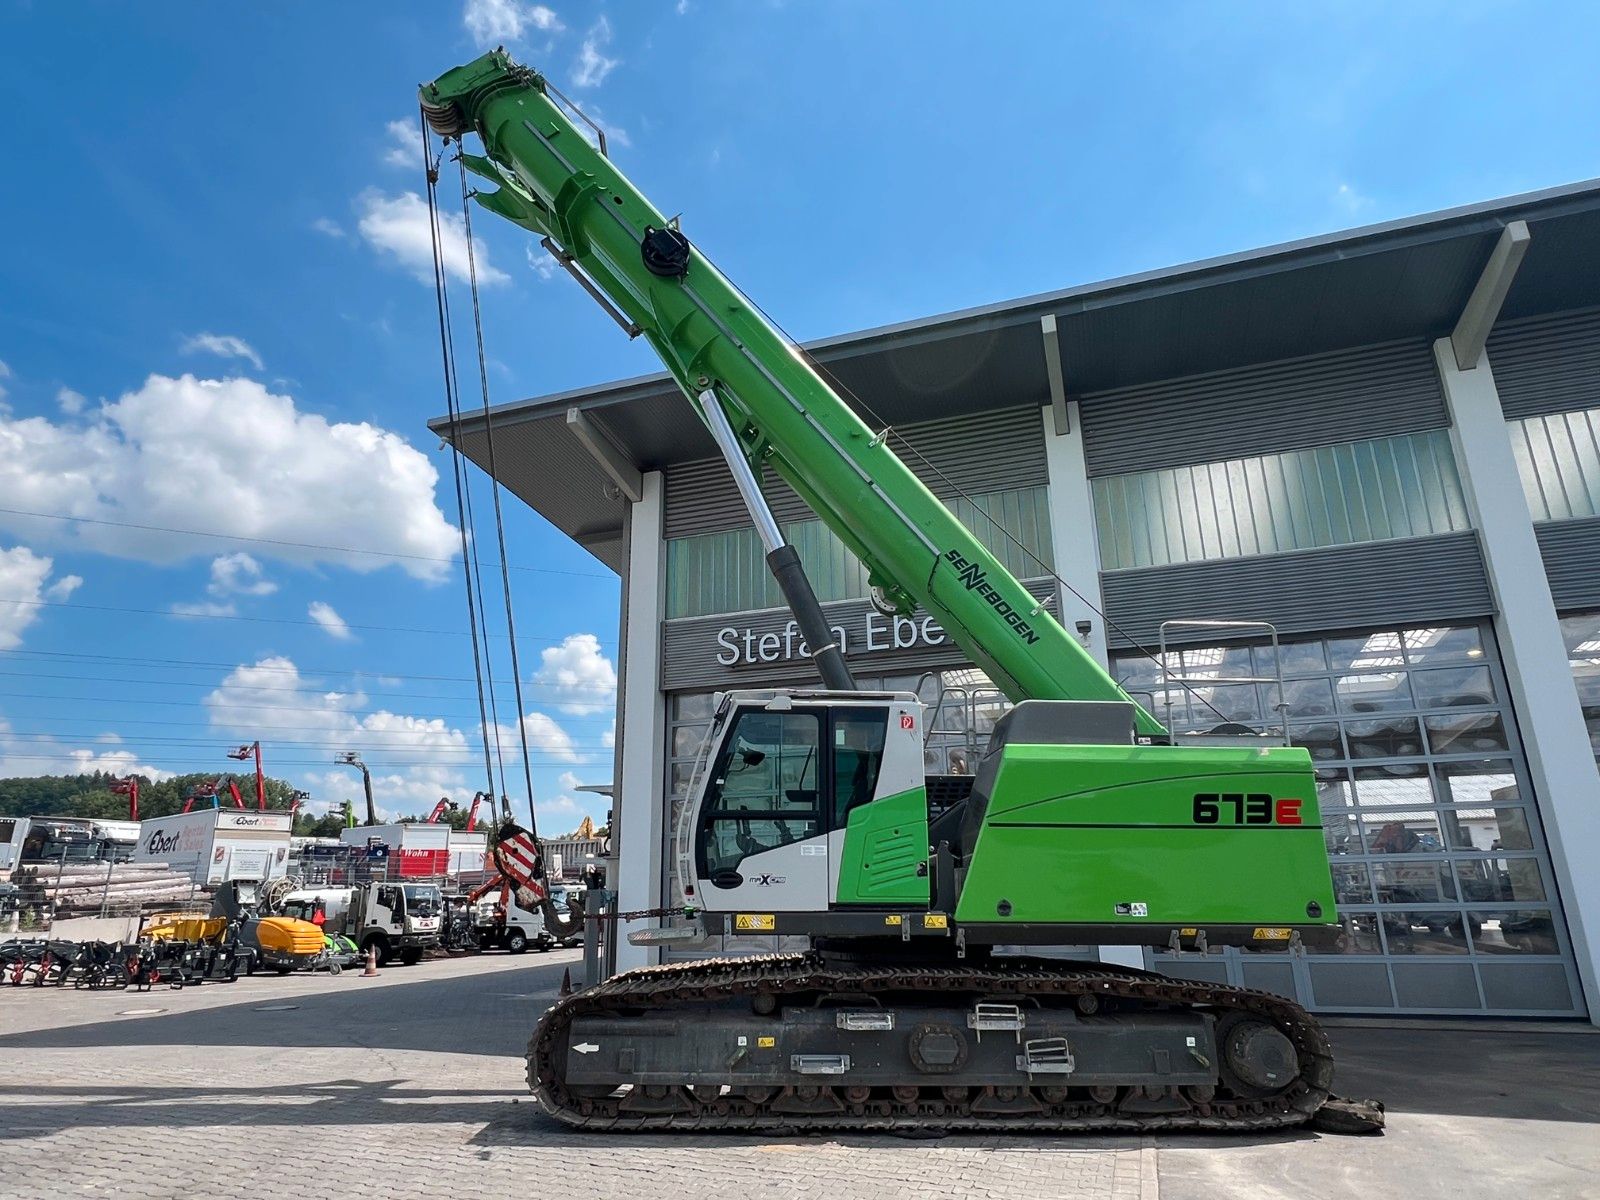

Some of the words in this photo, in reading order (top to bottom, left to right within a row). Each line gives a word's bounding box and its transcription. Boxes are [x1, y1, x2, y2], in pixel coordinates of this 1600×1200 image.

[944, 549, 1040, 645] SENNEBOGEN
[866, 611, 945, 651] Ebe
[235, 816, 259, 826] Ebert
[1192, 793, 1302, 825] 673E
[149, 829, 180, 855] Ebert
[403, 849, 429, 858] Wohn
